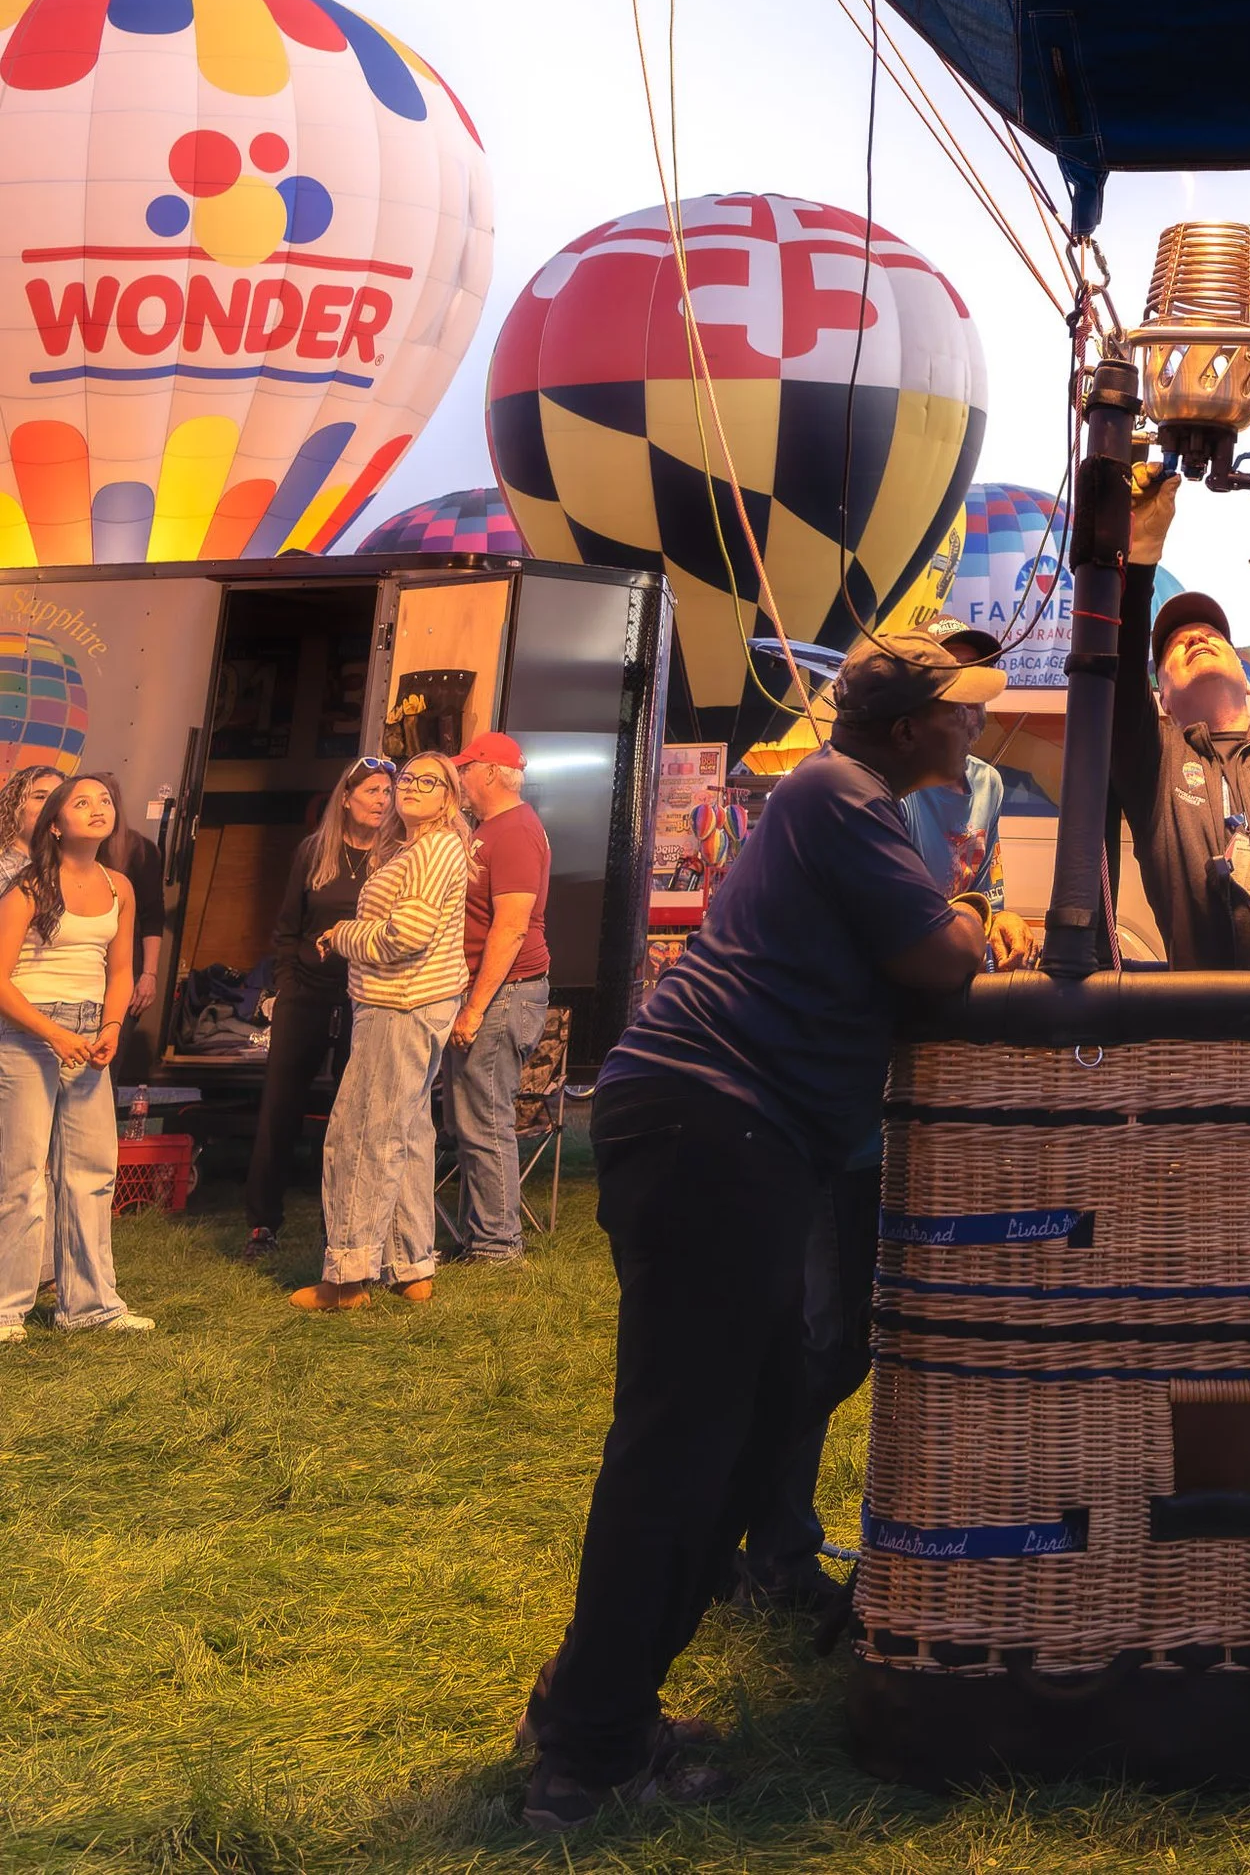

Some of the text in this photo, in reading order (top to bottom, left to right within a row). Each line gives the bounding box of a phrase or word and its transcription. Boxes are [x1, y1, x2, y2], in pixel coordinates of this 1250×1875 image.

[26, 274, 393, 364] WONDER
[969, 599, 1072, 623] FARME
[12, 589, 107, 659] Sapphire
[995, 626, 1072, 643] INSURANC
[1010, 656, 1042, 671] BACA
[1043, 655, 1066, 669] AGE
